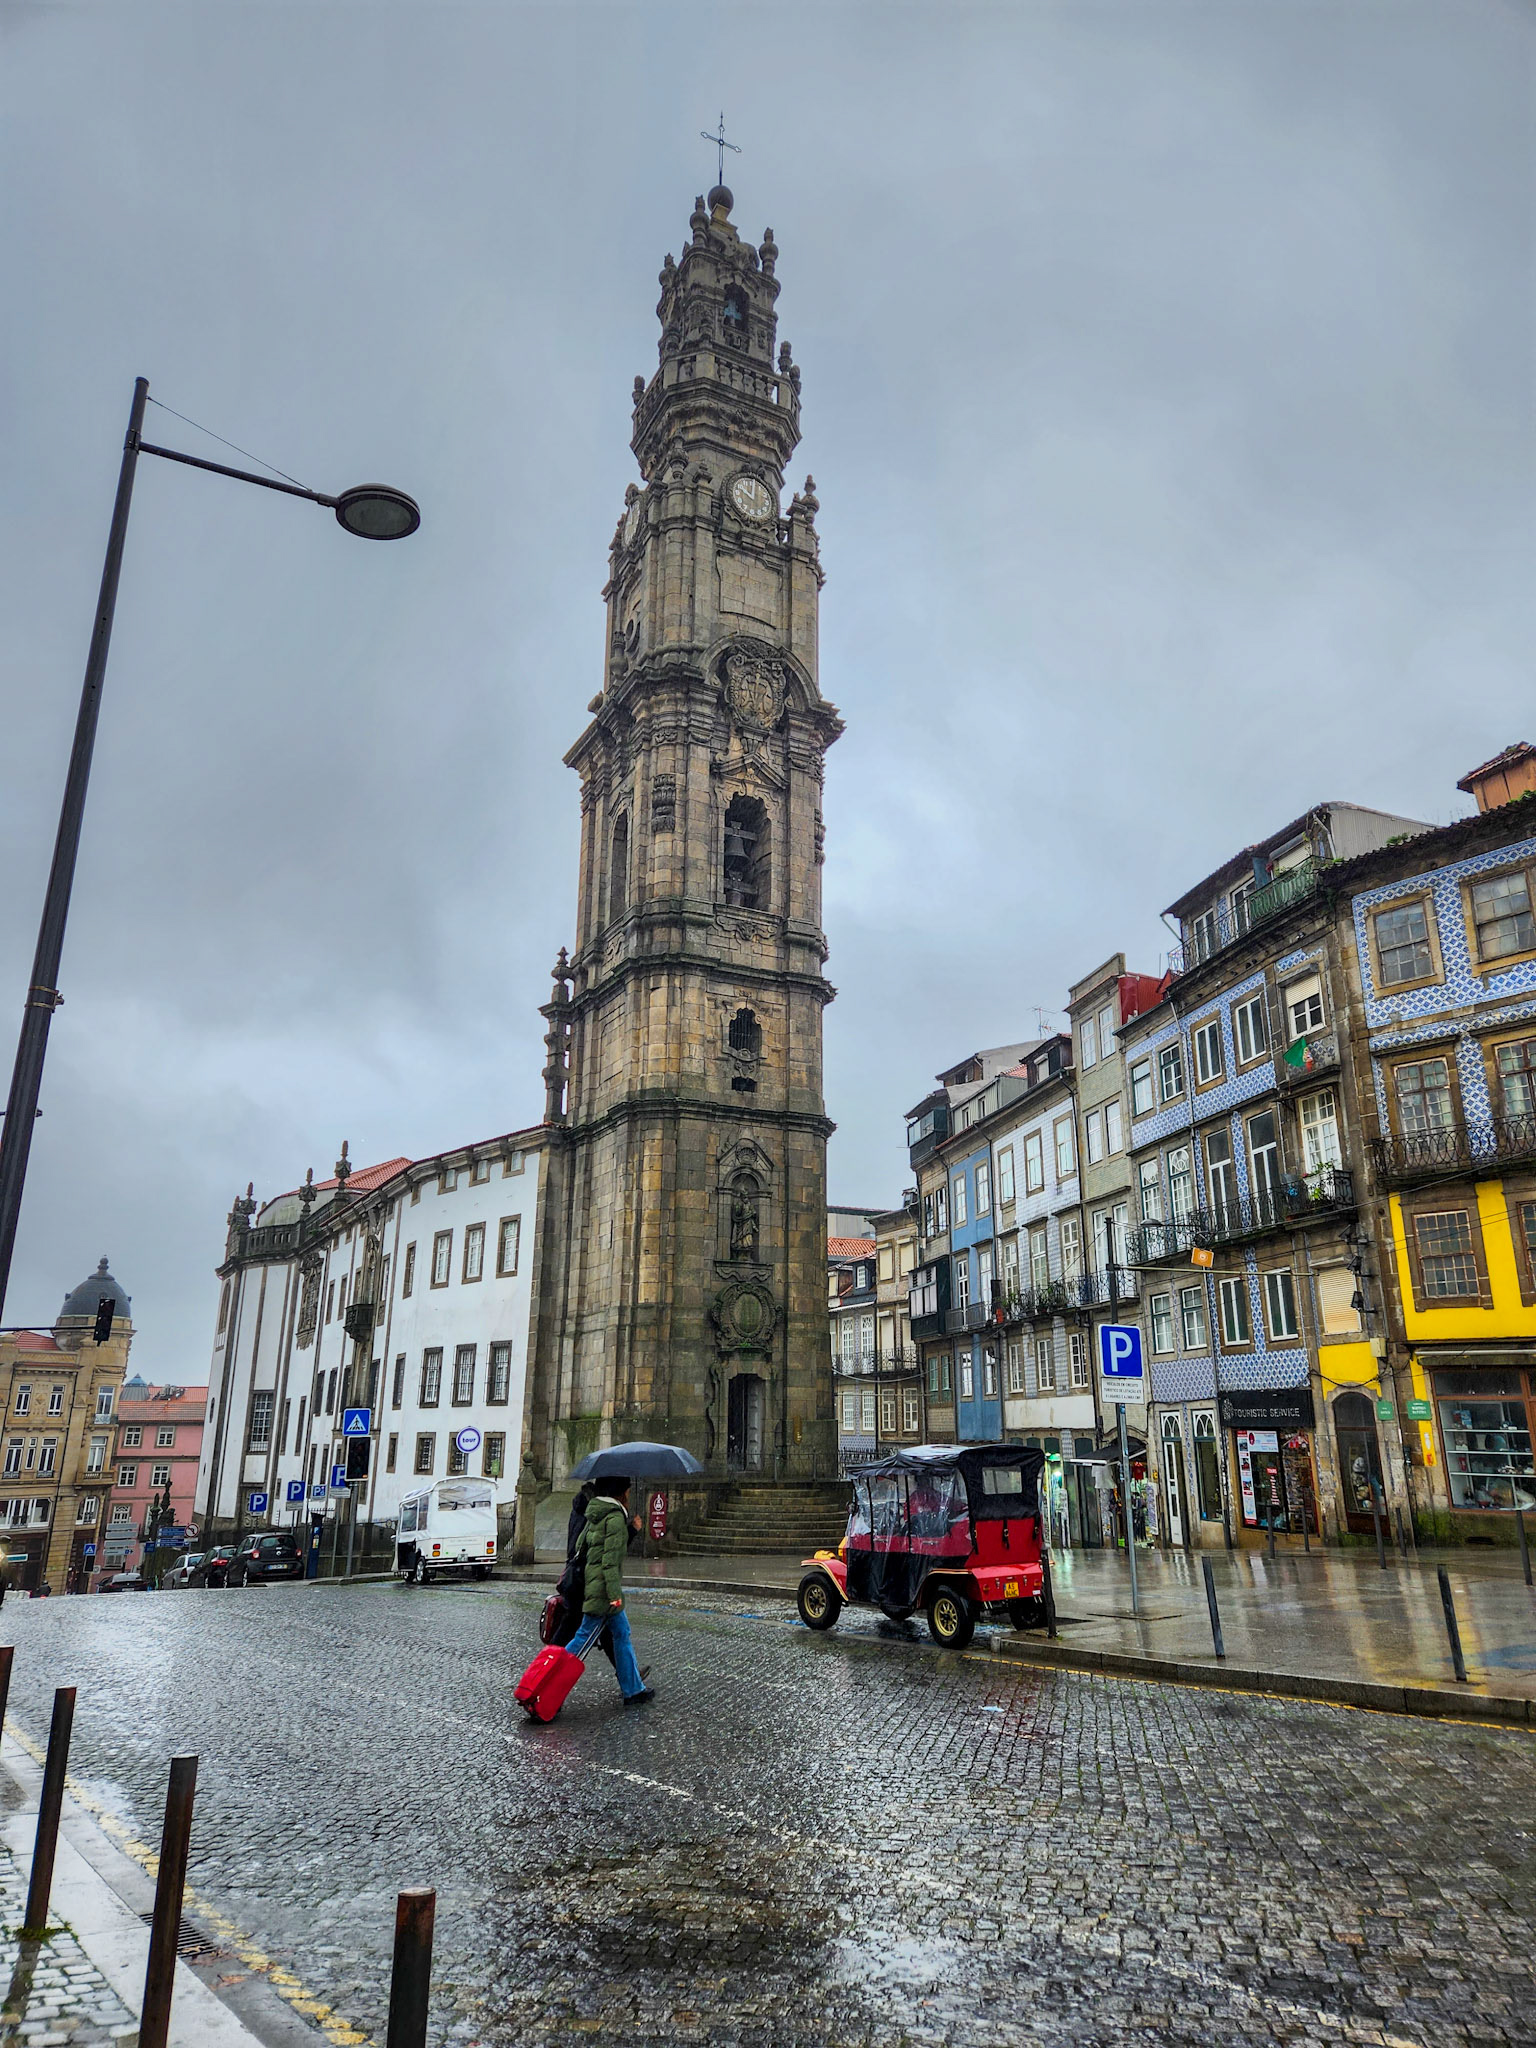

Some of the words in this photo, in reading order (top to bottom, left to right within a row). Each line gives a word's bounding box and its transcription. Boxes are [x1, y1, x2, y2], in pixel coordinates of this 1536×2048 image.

[1109, 1330, 1133, 1373] P
[1234, 1408, 1267, 1418] TOURISTIC
[1270, 1408, 1300, 1418] SERVICE
[291, 1483, 302, 1500] P
[314, 1486, 321, 1496] P
[253, 1495, 264, 1511] P
